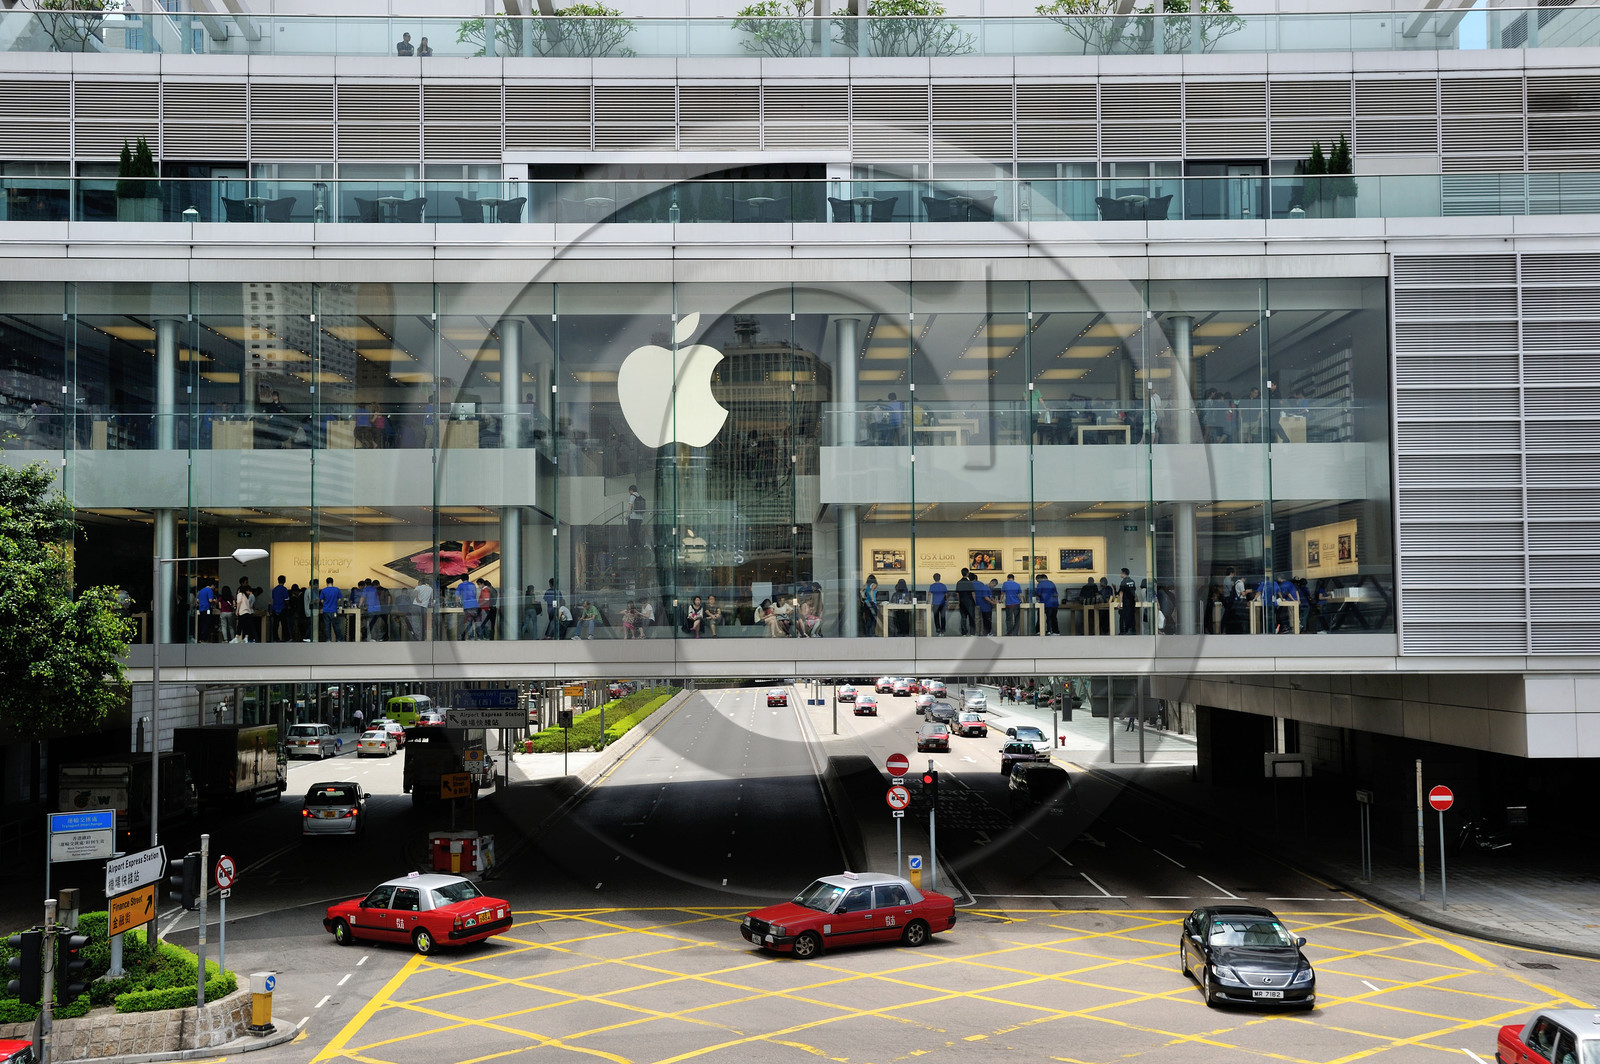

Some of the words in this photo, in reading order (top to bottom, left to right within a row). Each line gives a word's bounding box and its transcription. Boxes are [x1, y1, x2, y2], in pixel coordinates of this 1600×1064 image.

[939, 552, 955, 560] Lion
[108, 862, 125, 873] Airport
[126, 856, 143, 869] Express
[143, 851, 159, 863] Station
[112, 900, 129, 912] Finance
[130, 895, 142, 906] Street
[112, 912, 130, 929] 金融街
